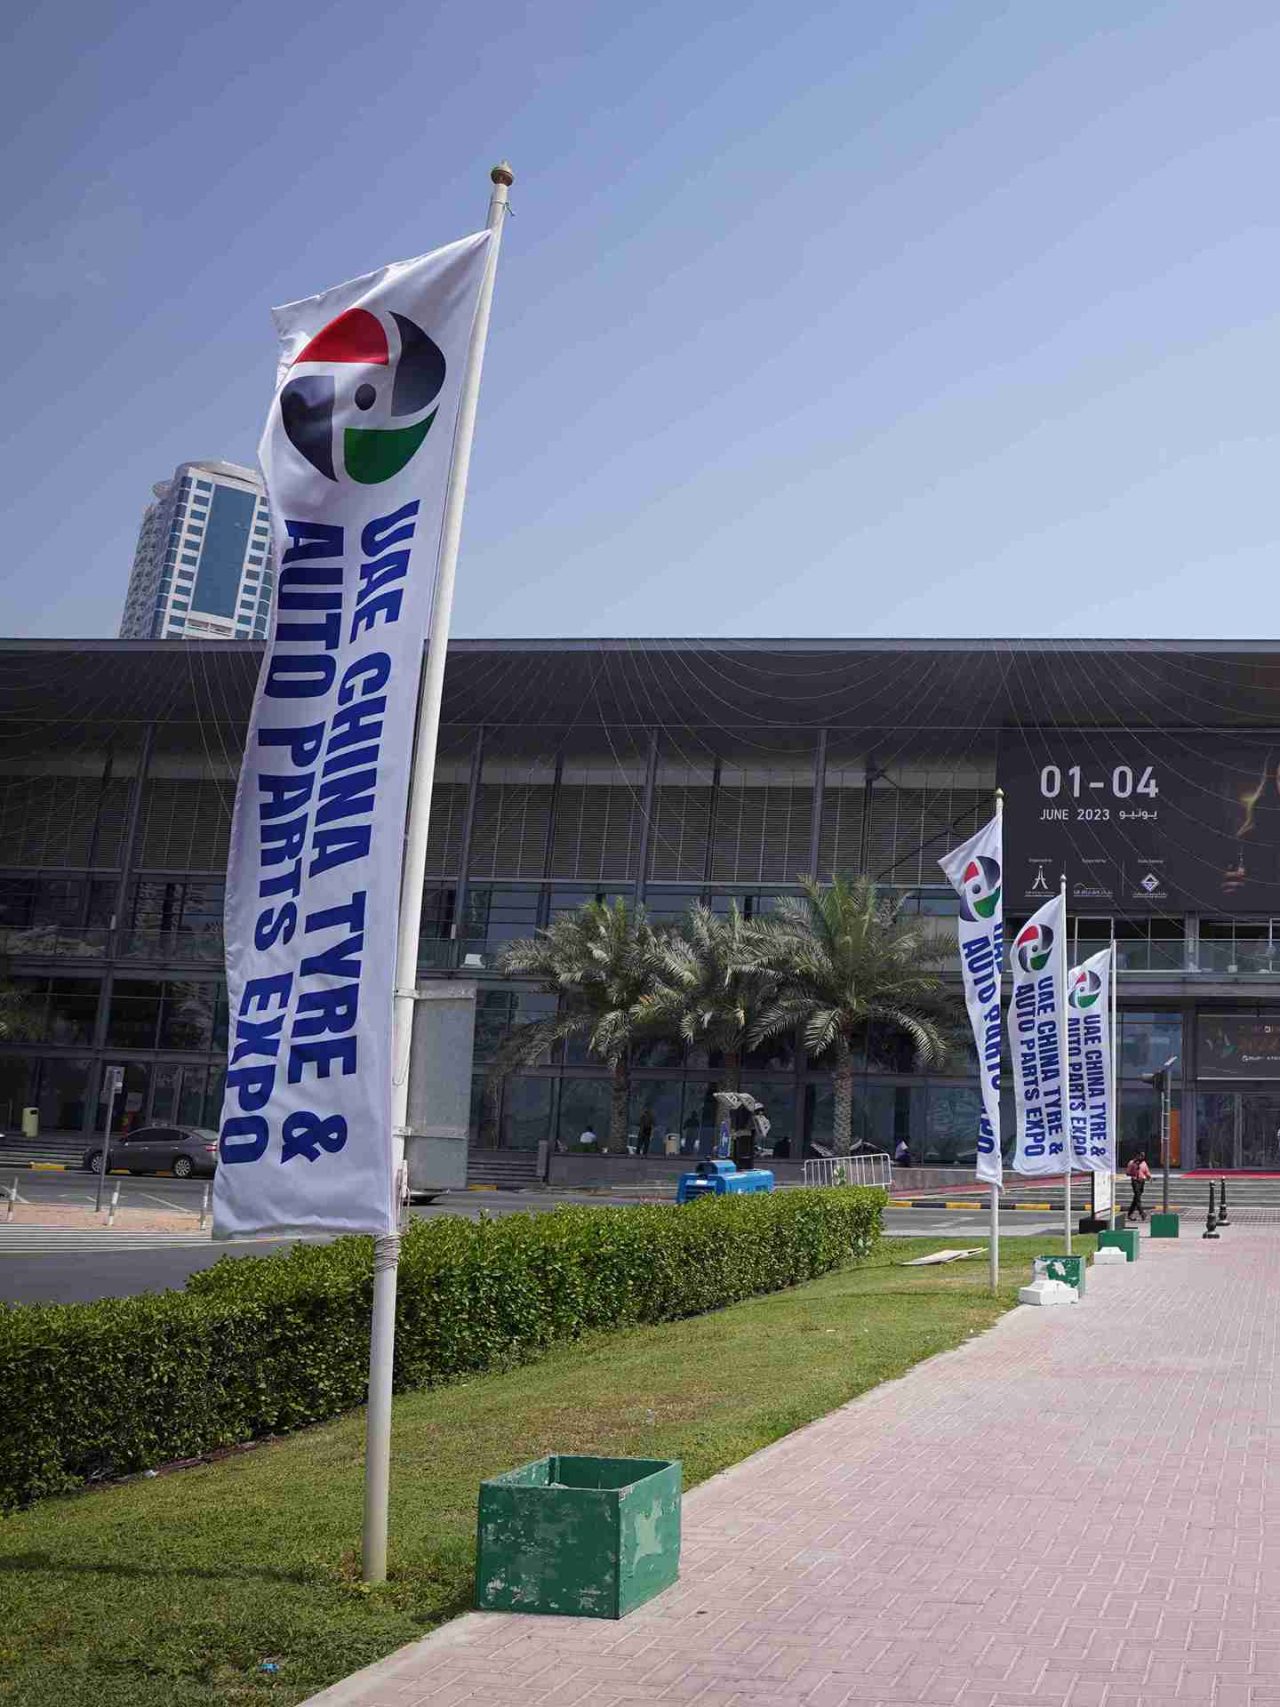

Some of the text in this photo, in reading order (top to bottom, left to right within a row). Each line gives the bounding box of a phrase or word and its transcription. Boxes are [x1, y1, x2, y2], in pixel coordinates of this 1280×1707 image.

[281, 499, 421, 1165] UAE CHINA TYRE &
[1040, 809, 1110, 820] JUNE 2023
[1119, 809, 1158, 820] يونيو
[219, 519, 345, 1165] AUTO PARTS EXPO
[1083, 1014, 1102, 1046] UAE
[1015, 983, 1046, 1157] AUTO PARTS EXPO
[1037, 976, 1064, 1156] UAE CHINA TYRE &
[1084, 1049, 1105, 1098] CHINA
[1070, 1117, 1087, 1156] EXPO
[1089, 1102, 1107, 1140] TYRE
